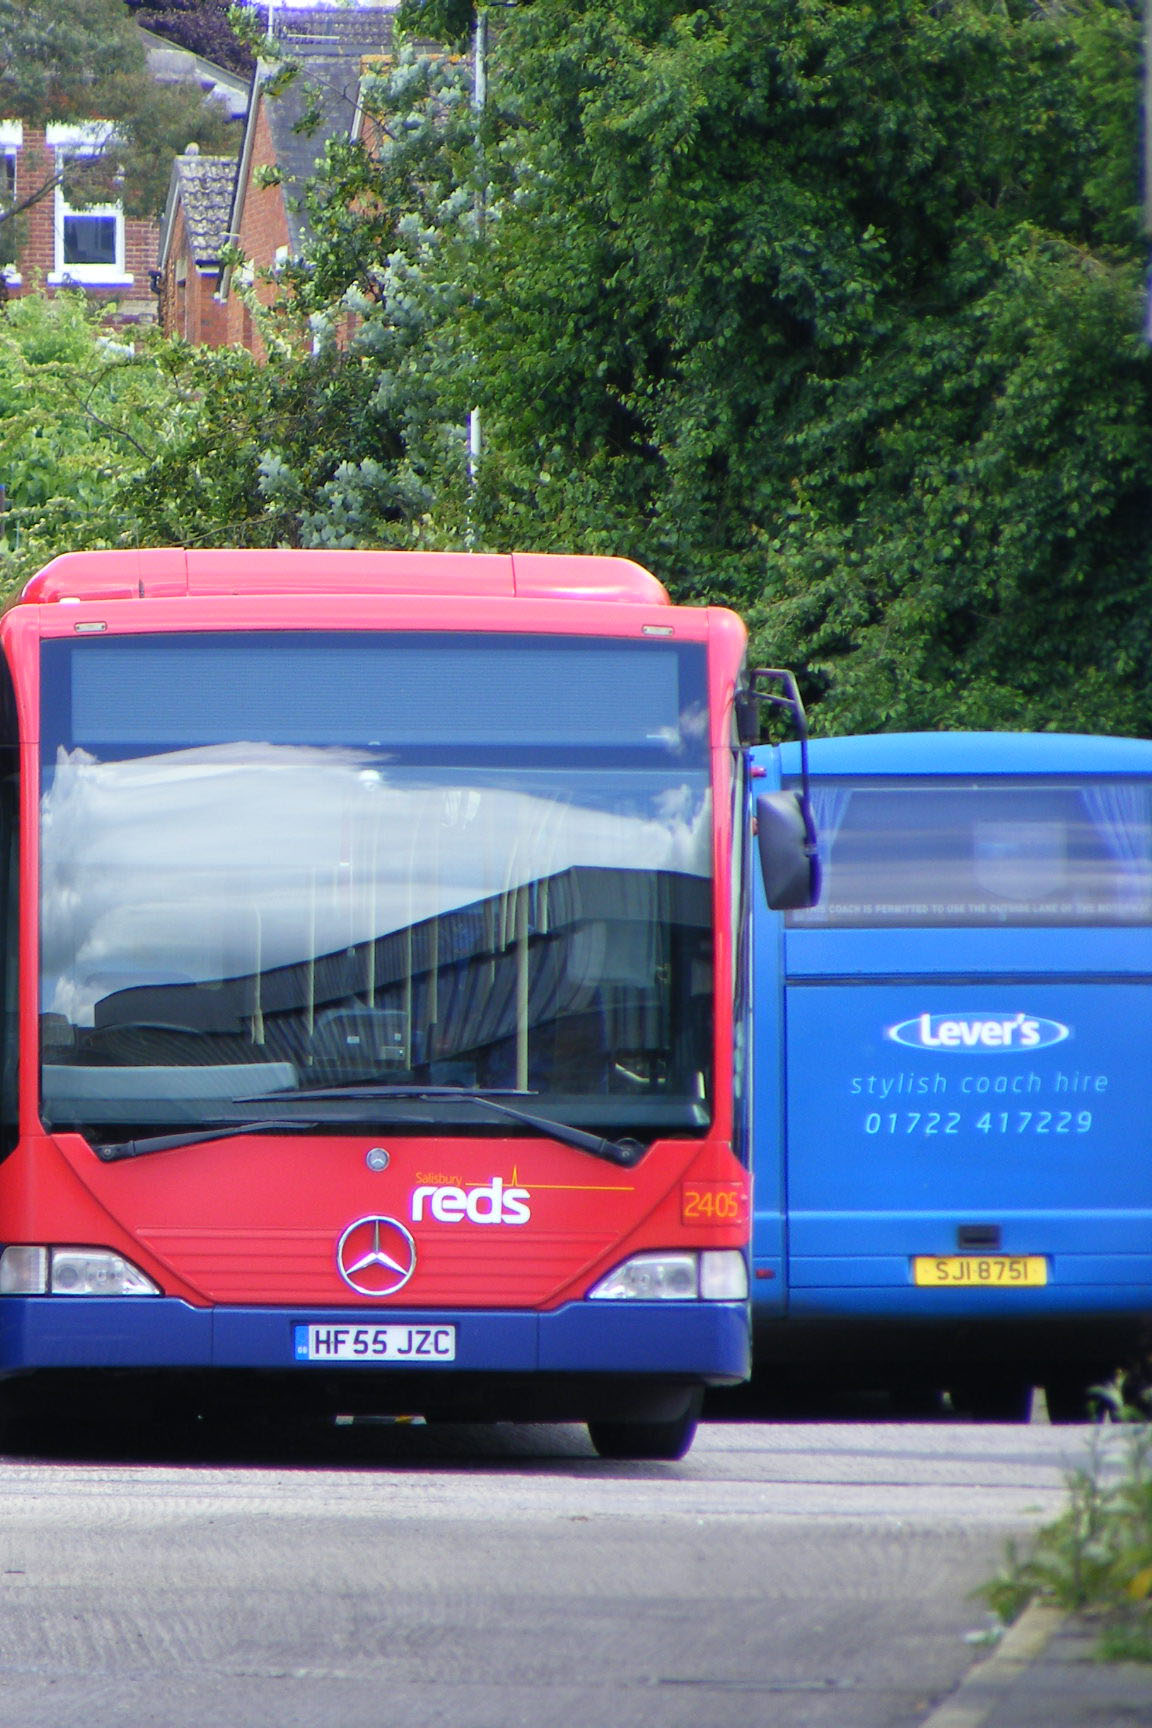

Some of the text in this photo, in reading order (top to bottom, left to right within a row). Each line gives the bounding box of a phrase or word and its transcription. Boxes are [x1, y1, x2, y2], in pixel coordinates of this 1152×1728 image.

[829, 903, 860, 914] COACH
[863, 903, 873, 914] IS
[875, 903, 928, 914] PERMITTED
[932, 903, 944, 914] TO
[947, 903, 965, 914] USE
[967, 903, 986, 914] THE
[919, 1013, 1041, 1046] Lever's
[851, 1071, 1109, 1099] stylish coach hire
[865, 1111, 1093, 1134] 01722 417229
[415, 1172, 463, 1187] Salisbury
[411, 1177, 532, 1225] reds
[683, 1191, 739, 1217] 2405
[314, 1330, 450, 1355] HF55 JZC
